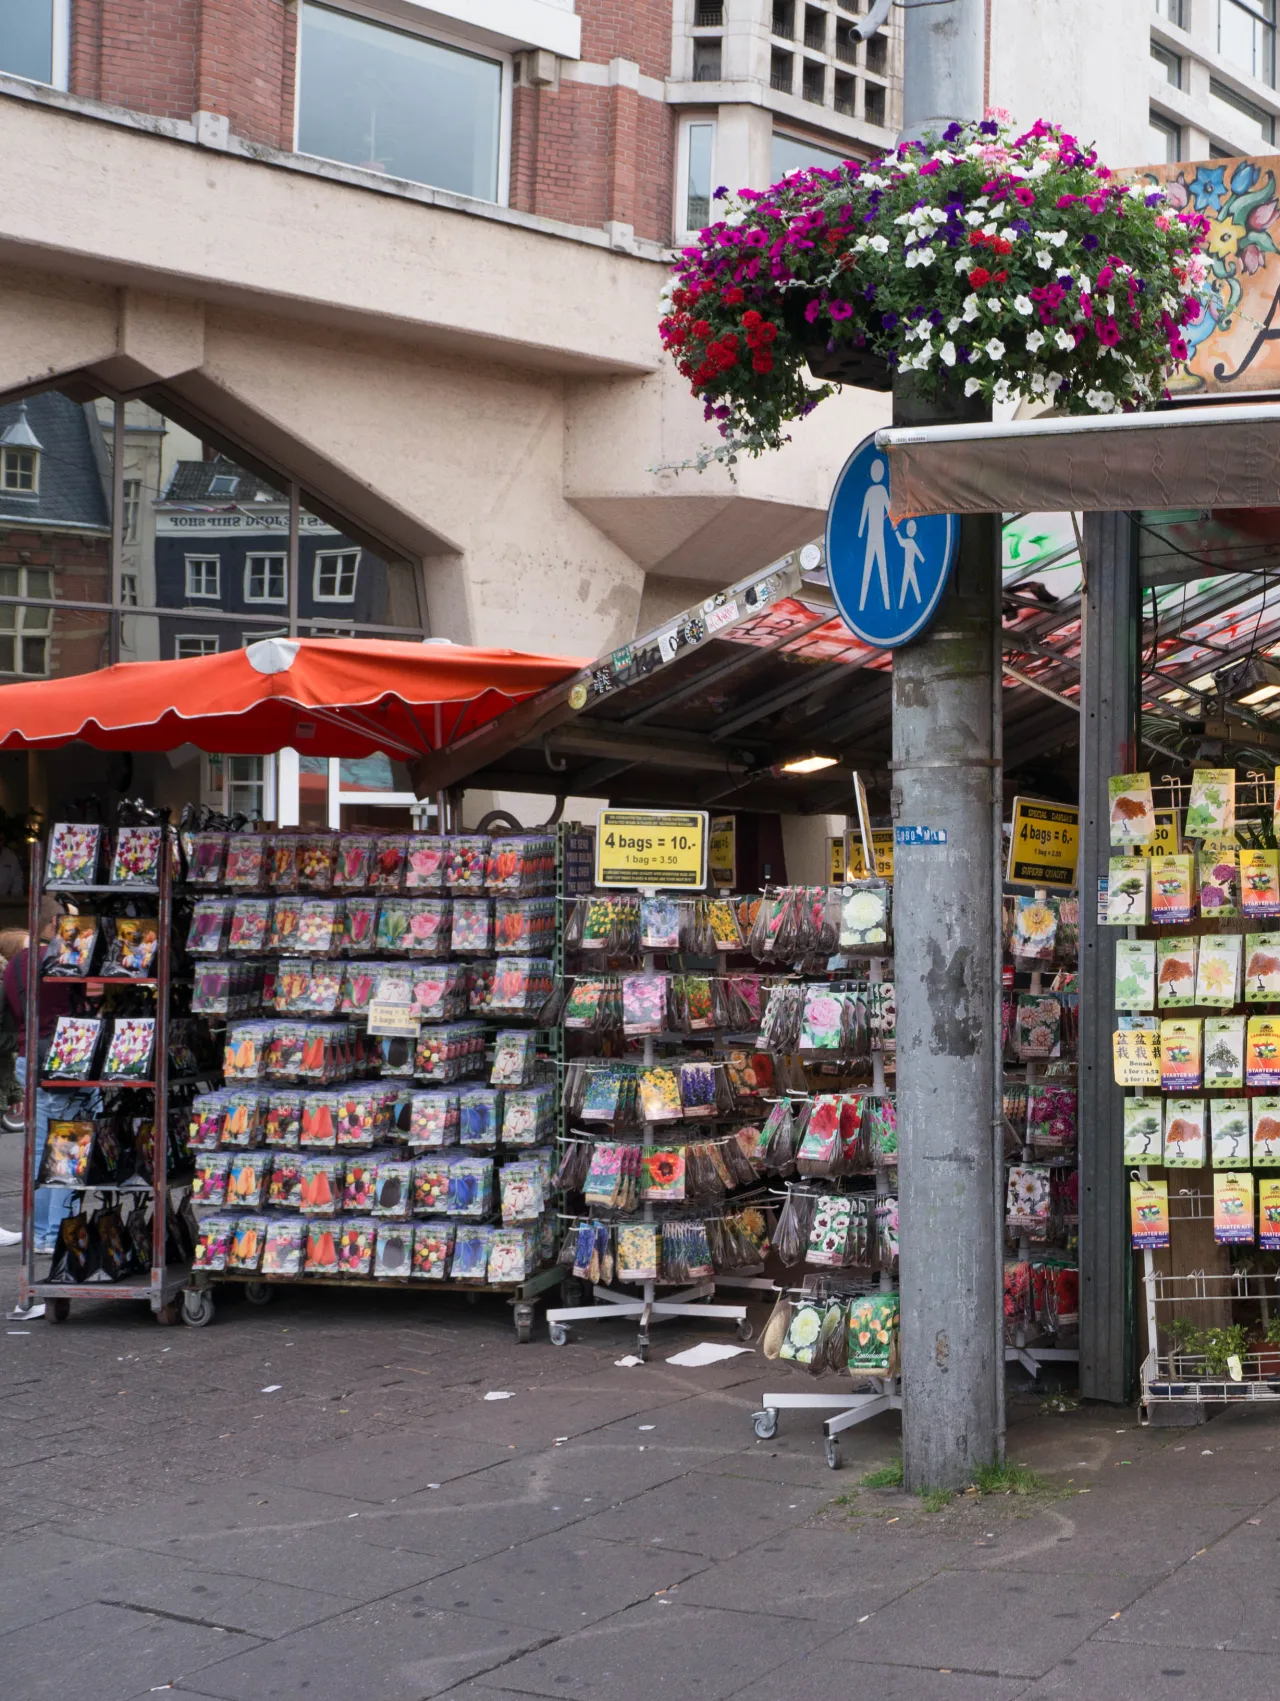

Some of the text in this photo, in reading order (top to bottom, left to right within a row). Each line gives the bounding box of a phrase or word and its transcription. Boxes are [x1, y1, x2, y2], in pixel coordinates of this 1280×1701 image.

[1020, 823, 1028, 841] 4
[1030, 824, 1052, 844] bags
[1054, 832, 1059, 840] =
[605, 832, 615, 848] 4
[619, 835, 652, 852] bags
[658, 838, 665, 846] =
[633, 856, 649, 865] bag
[660, 856, 677, 864] 3.50
[854, 861, 862, 873] 4
